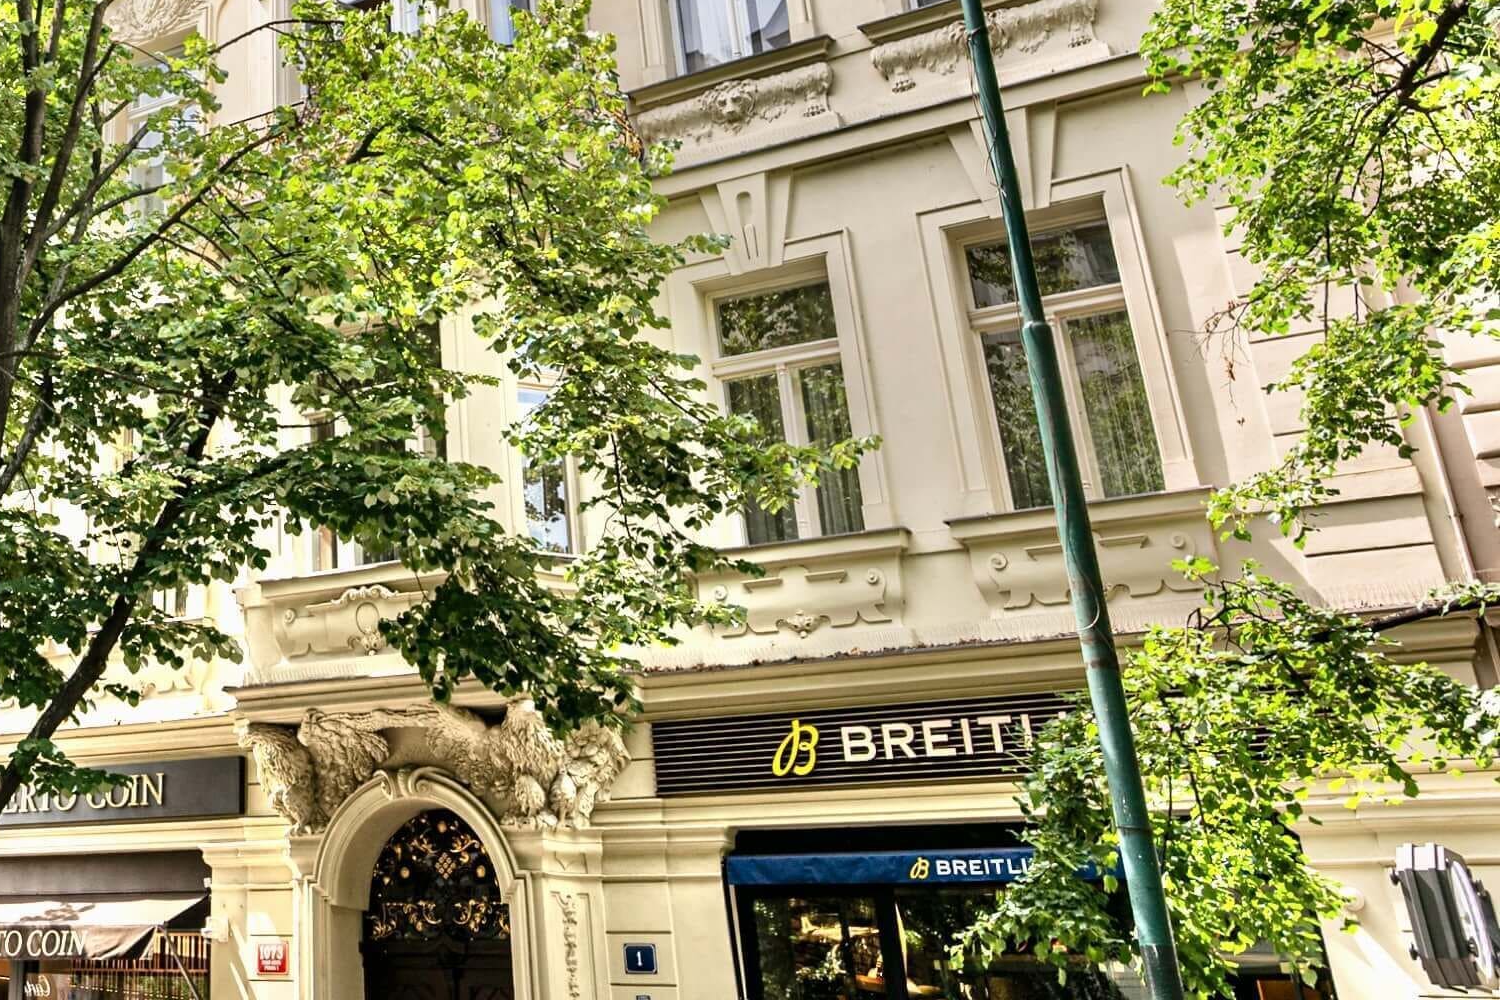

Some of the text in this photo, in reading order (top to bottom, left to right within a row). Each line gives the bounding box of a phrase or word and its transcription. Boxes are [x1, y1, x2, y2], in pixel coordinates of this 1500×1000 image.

[840, 711, 1066, 762] BREITL
[935, 857, 1033, 876] BREITLI
[26, 930, 88, 957] COIN
[636, 951, 643, 967] 1
